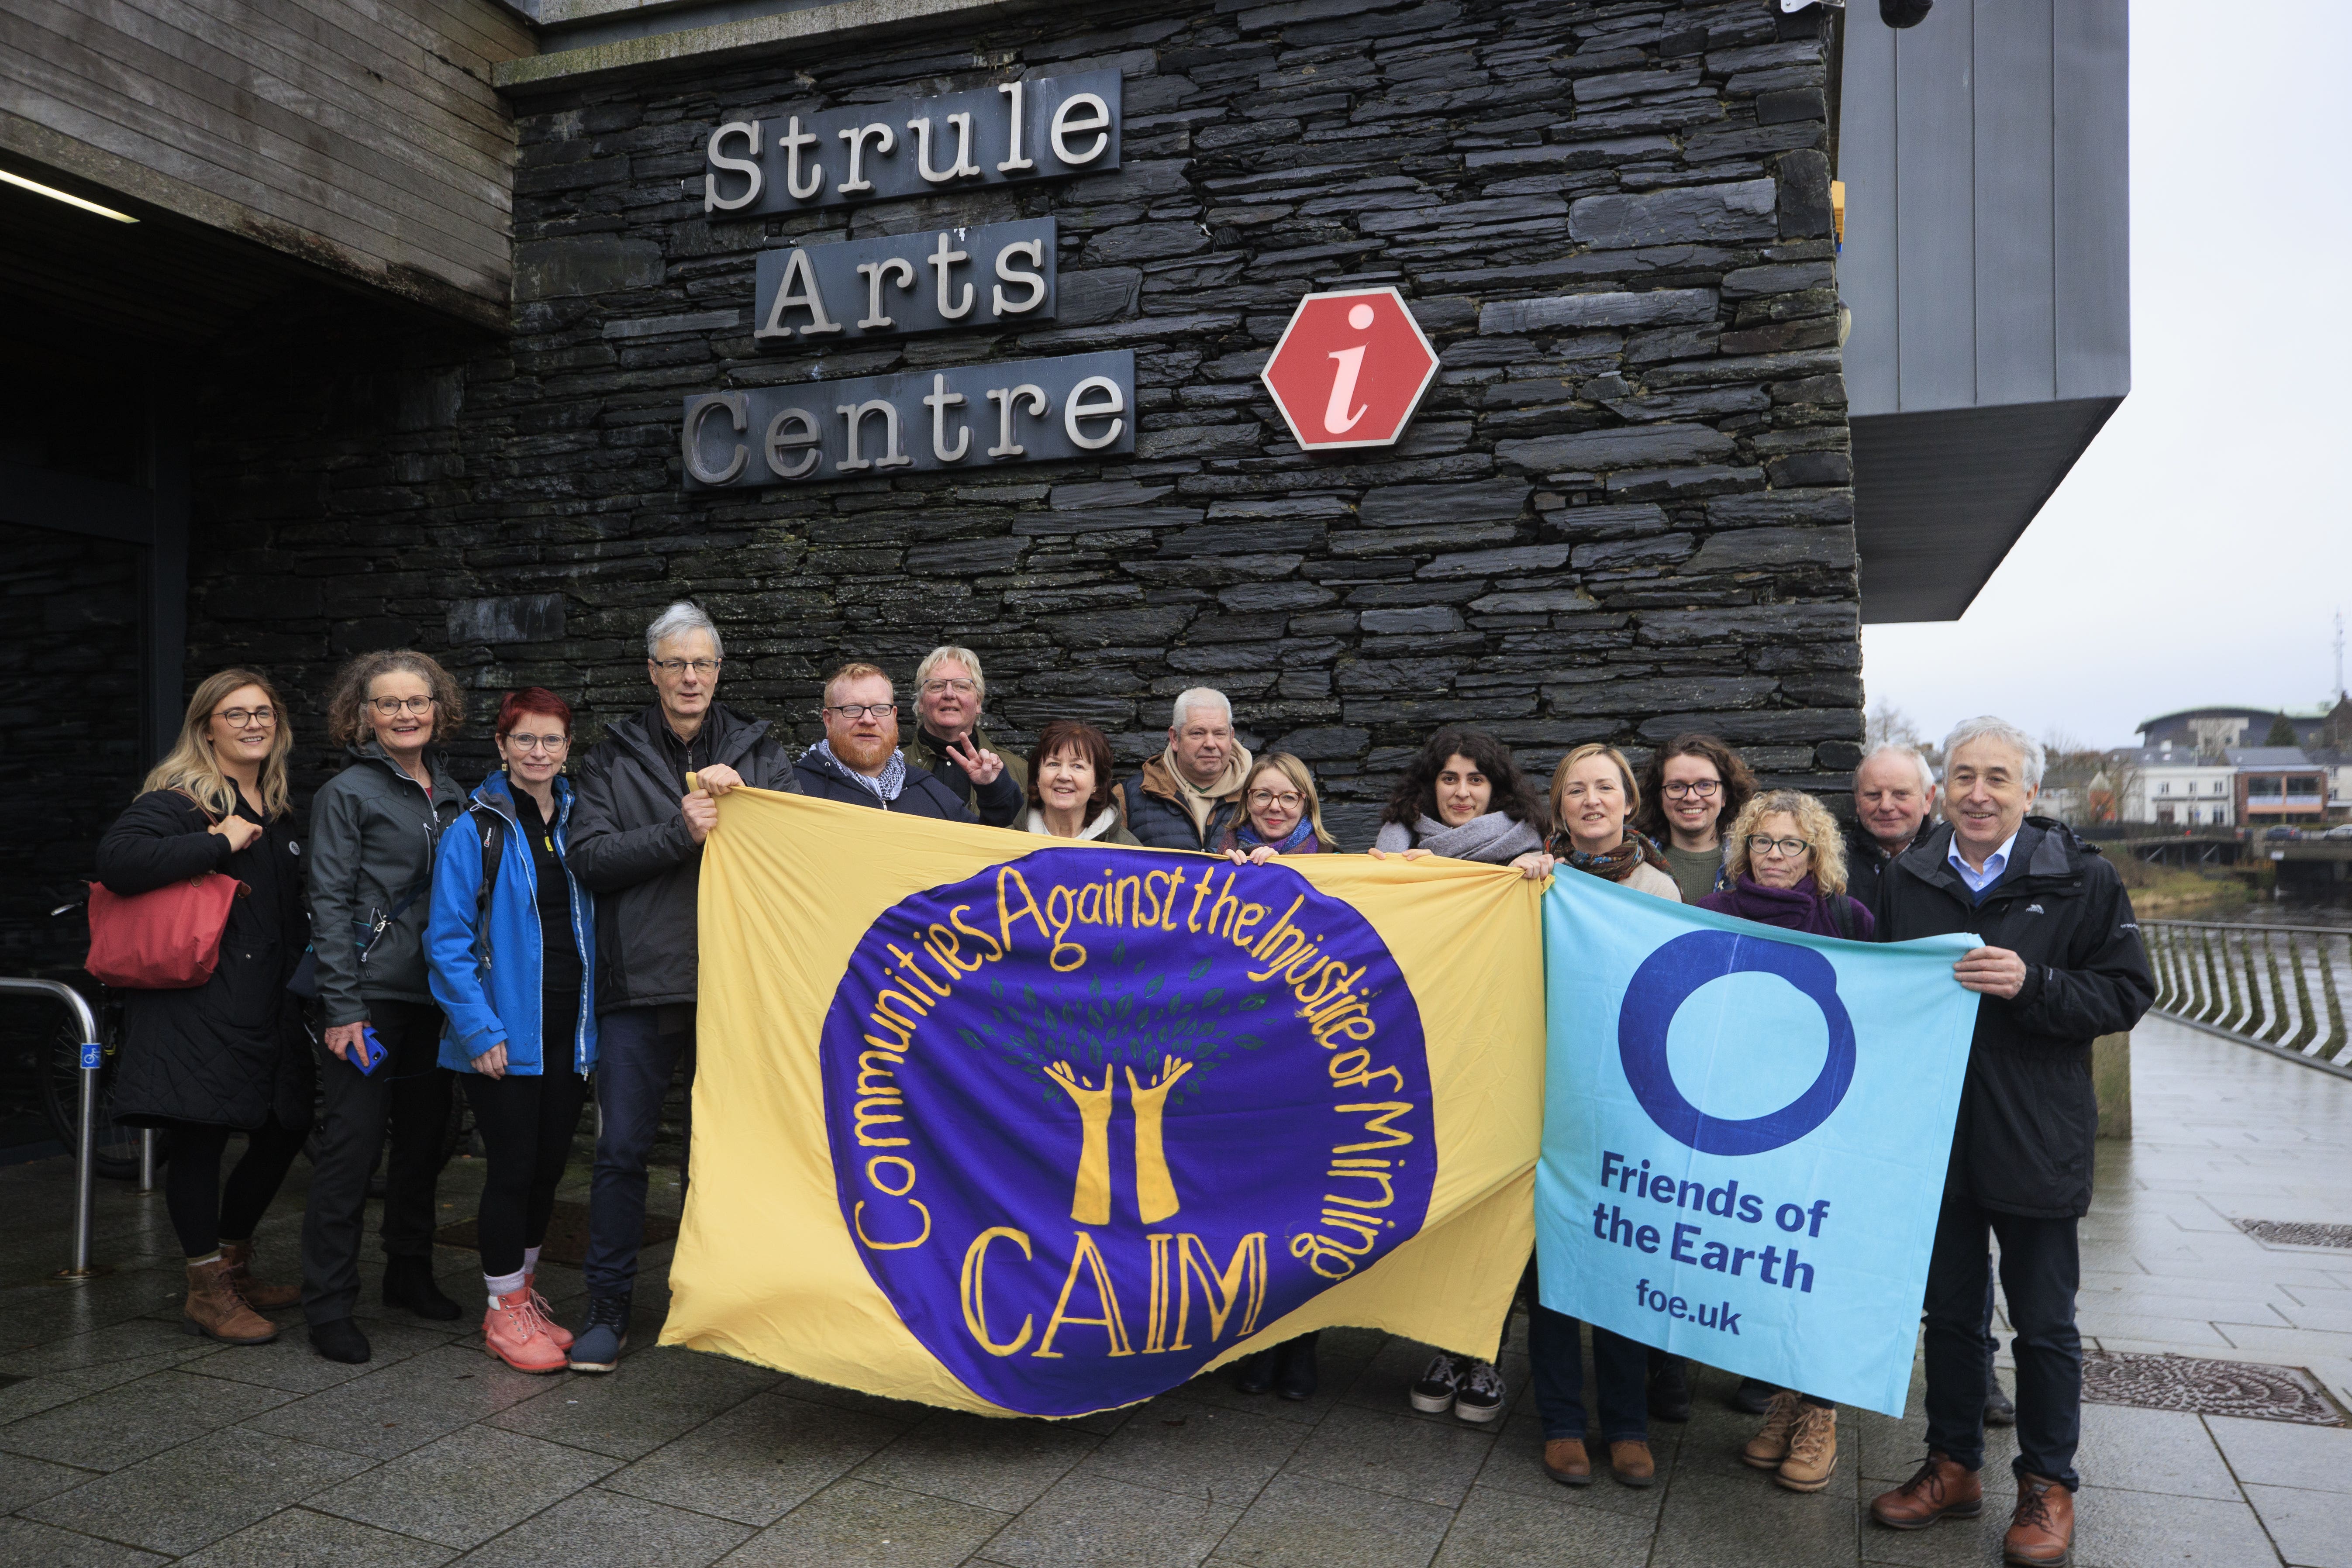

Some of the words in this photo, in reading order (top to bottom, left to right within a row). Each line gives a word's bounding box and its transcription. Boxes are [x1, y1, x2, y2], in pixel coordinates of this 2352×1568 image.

[705, 80, 1113, 214] Strule
[753, 232, 1049, 341] Arts
[1325, 303, 1376, 435] i
[682, 373, 1127, 486] Centre
[996, 866, 1186, 972] Against
[1187, 866, 1266, 947] the
[1247, 893, 1376, 1050] Injustice
[853, 904, 1004, 1251] Communities
[1328, 1046, 1404, 1093] of
[1289, 1100, 1414, 1280] Mining
[1601, 1150, 1764, 1224] Friends
[1775, 1199, 1831, 1238] of
[960, 1226, 1268, 1358] CAIM
[1592, 1202, 1660, 1254] the
[1670, 1222, 1815, 1293] Earth
[1636, 1278, 1742, 1336] foe.uk
